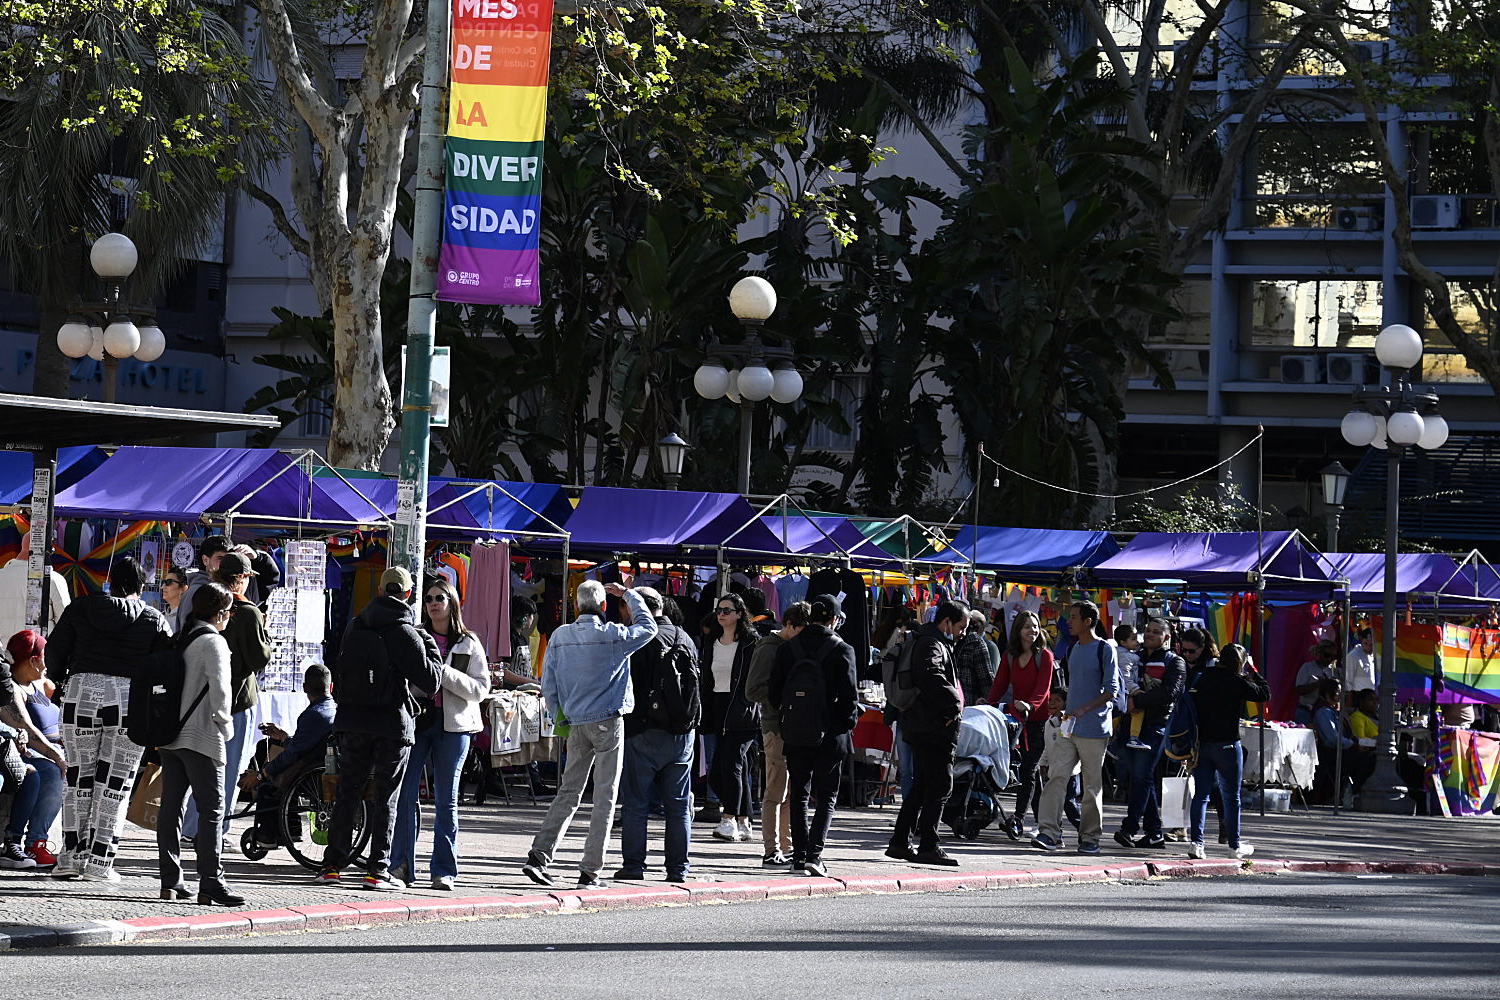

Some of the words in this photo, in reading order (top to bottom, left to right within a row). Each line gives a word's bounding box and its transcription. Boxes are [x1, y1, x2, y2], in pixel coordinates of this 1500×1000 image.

[454, 44, 493, 71] DE
[456, 99, 488, 127] LA
[453, 151, 539, 182] DIVER
[451, 204, 536, 235] SIDAD
[458, 278, 480, 287] CENTRO
[460, 271, 480, 280] GRUPO
[17, 349, 103, 382] PZA
[121, 358, 208, 394] HOTEL
